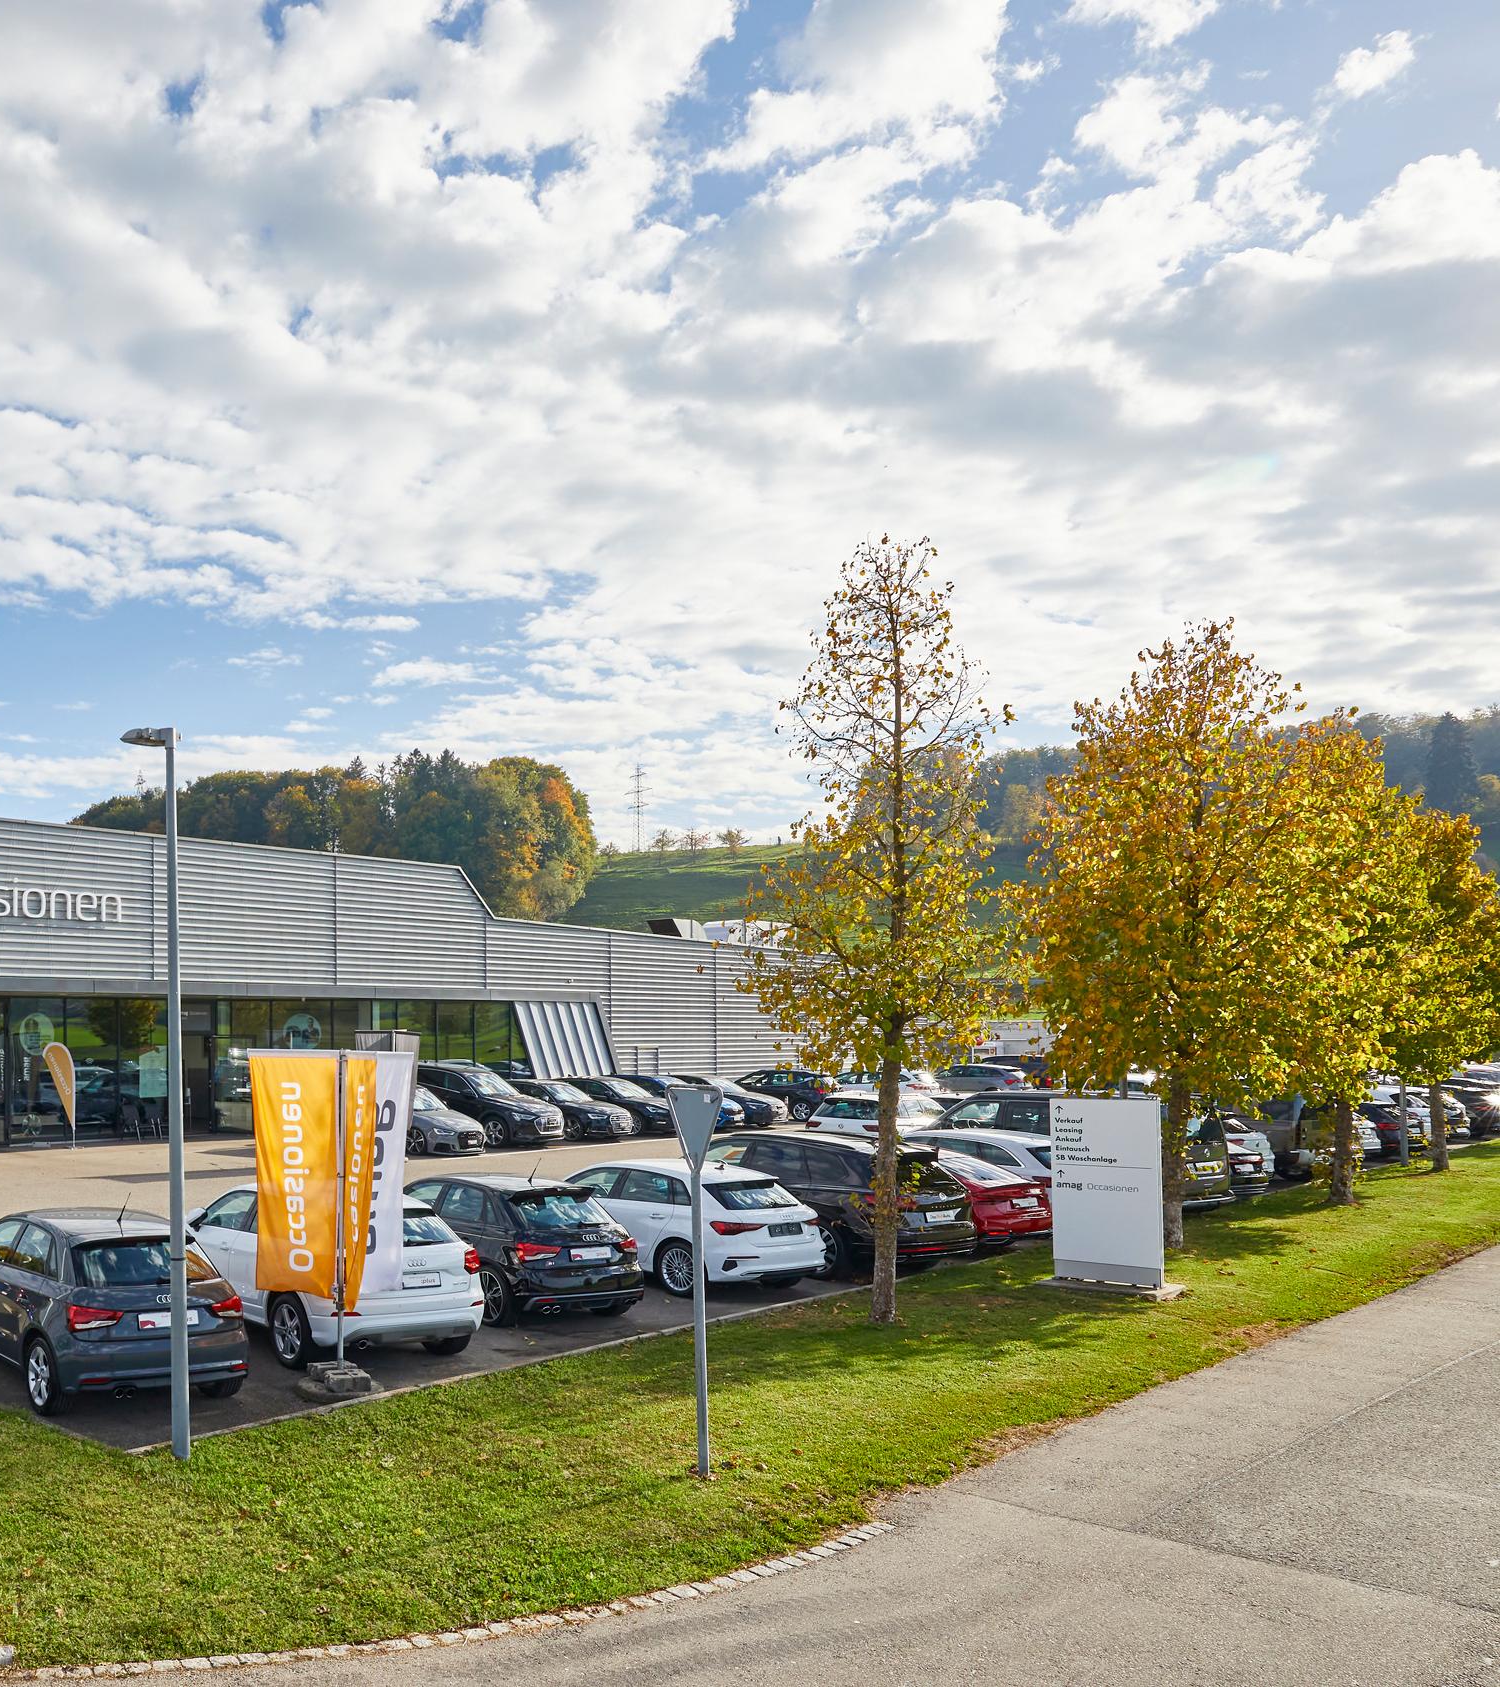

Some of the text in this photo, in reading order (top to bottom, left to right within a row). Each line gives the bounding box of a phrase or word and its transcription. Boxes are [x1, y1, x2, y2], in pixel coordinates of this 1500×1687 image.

[348, 1085, 365, 1244] casionen
[1068, 1155, 1117, 1164] Waschanlage
[1056, 1181, 1139, 1193] amag Occasionen
